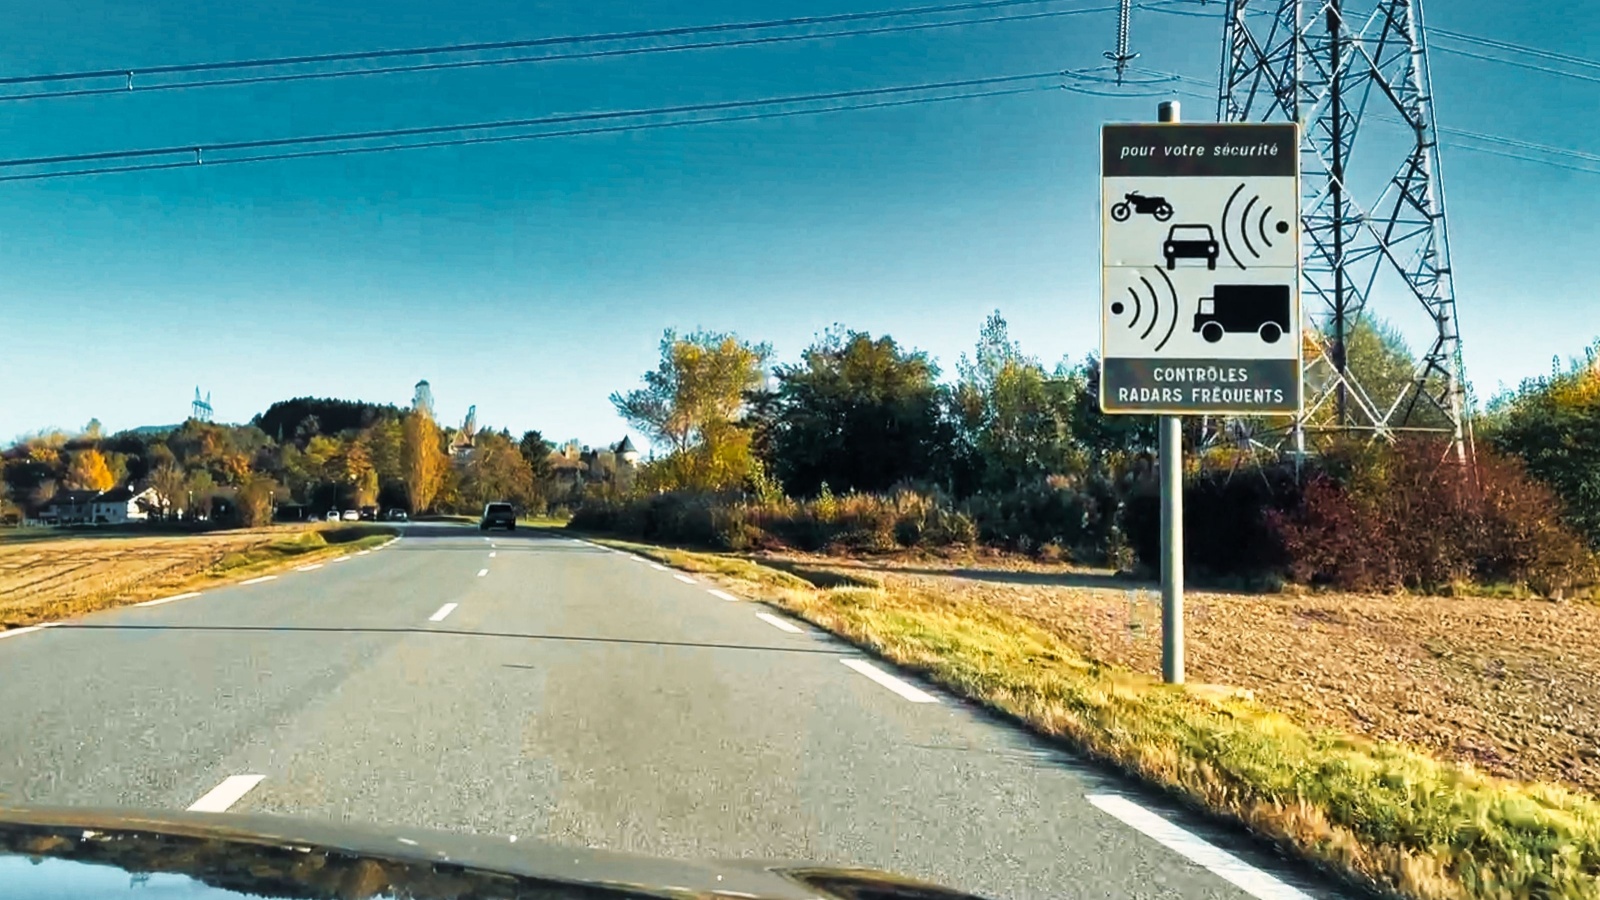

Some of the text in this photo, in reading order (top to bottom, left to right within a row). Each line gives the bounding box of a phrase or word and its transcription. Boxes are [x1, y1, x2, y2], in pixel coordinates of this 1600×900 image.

[1120, 142, 1279, 159] pour votre sécurité
[1153, 366, 1248, 382] CONTRÔLES
[1118, 385, 1284, 403] RADARS FRÉQUENTS
